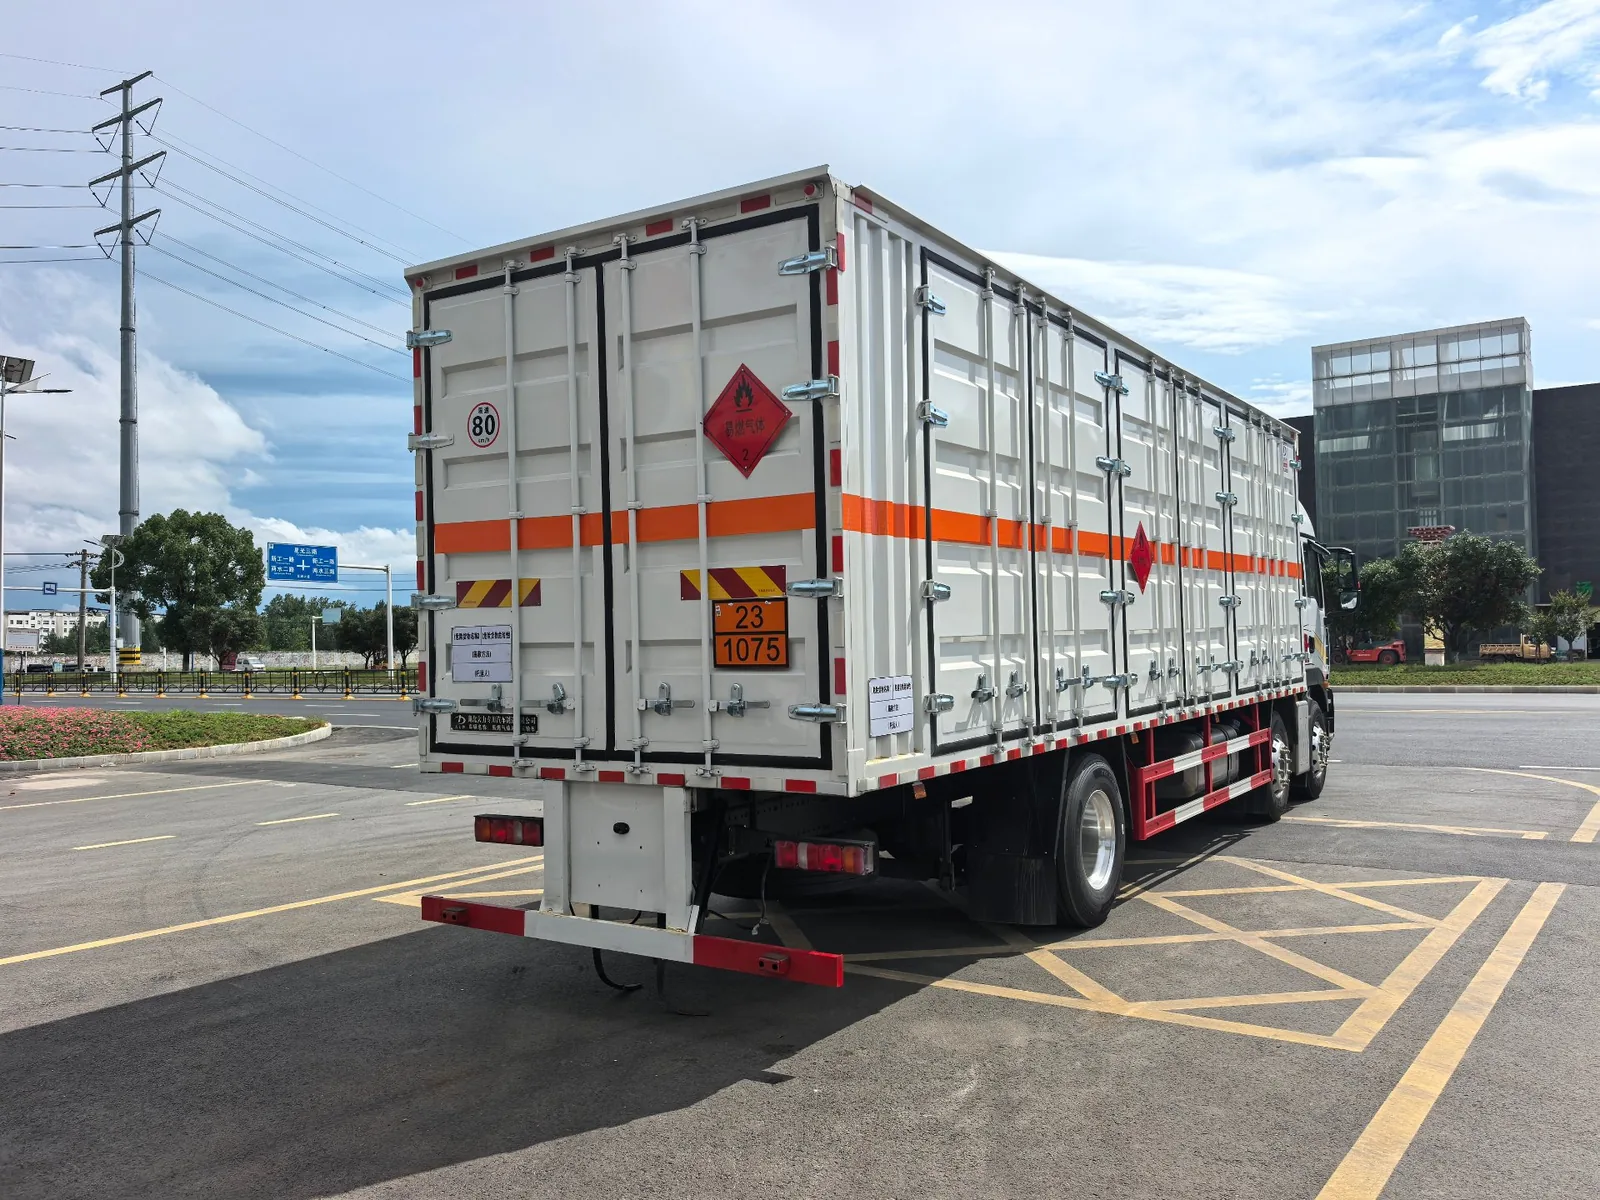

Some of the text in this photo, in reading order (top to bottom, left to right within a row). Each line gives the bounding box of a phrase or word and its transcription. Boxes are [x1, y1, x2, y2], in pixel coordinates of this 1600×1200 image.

[472, 414, 495, 436] 80
[725, 417, 765, 438] 易燃气体
[742, 449, 749, 461] 2
[735, 604, 764, 629] 23
[723, 636, 780, 662] 1075
